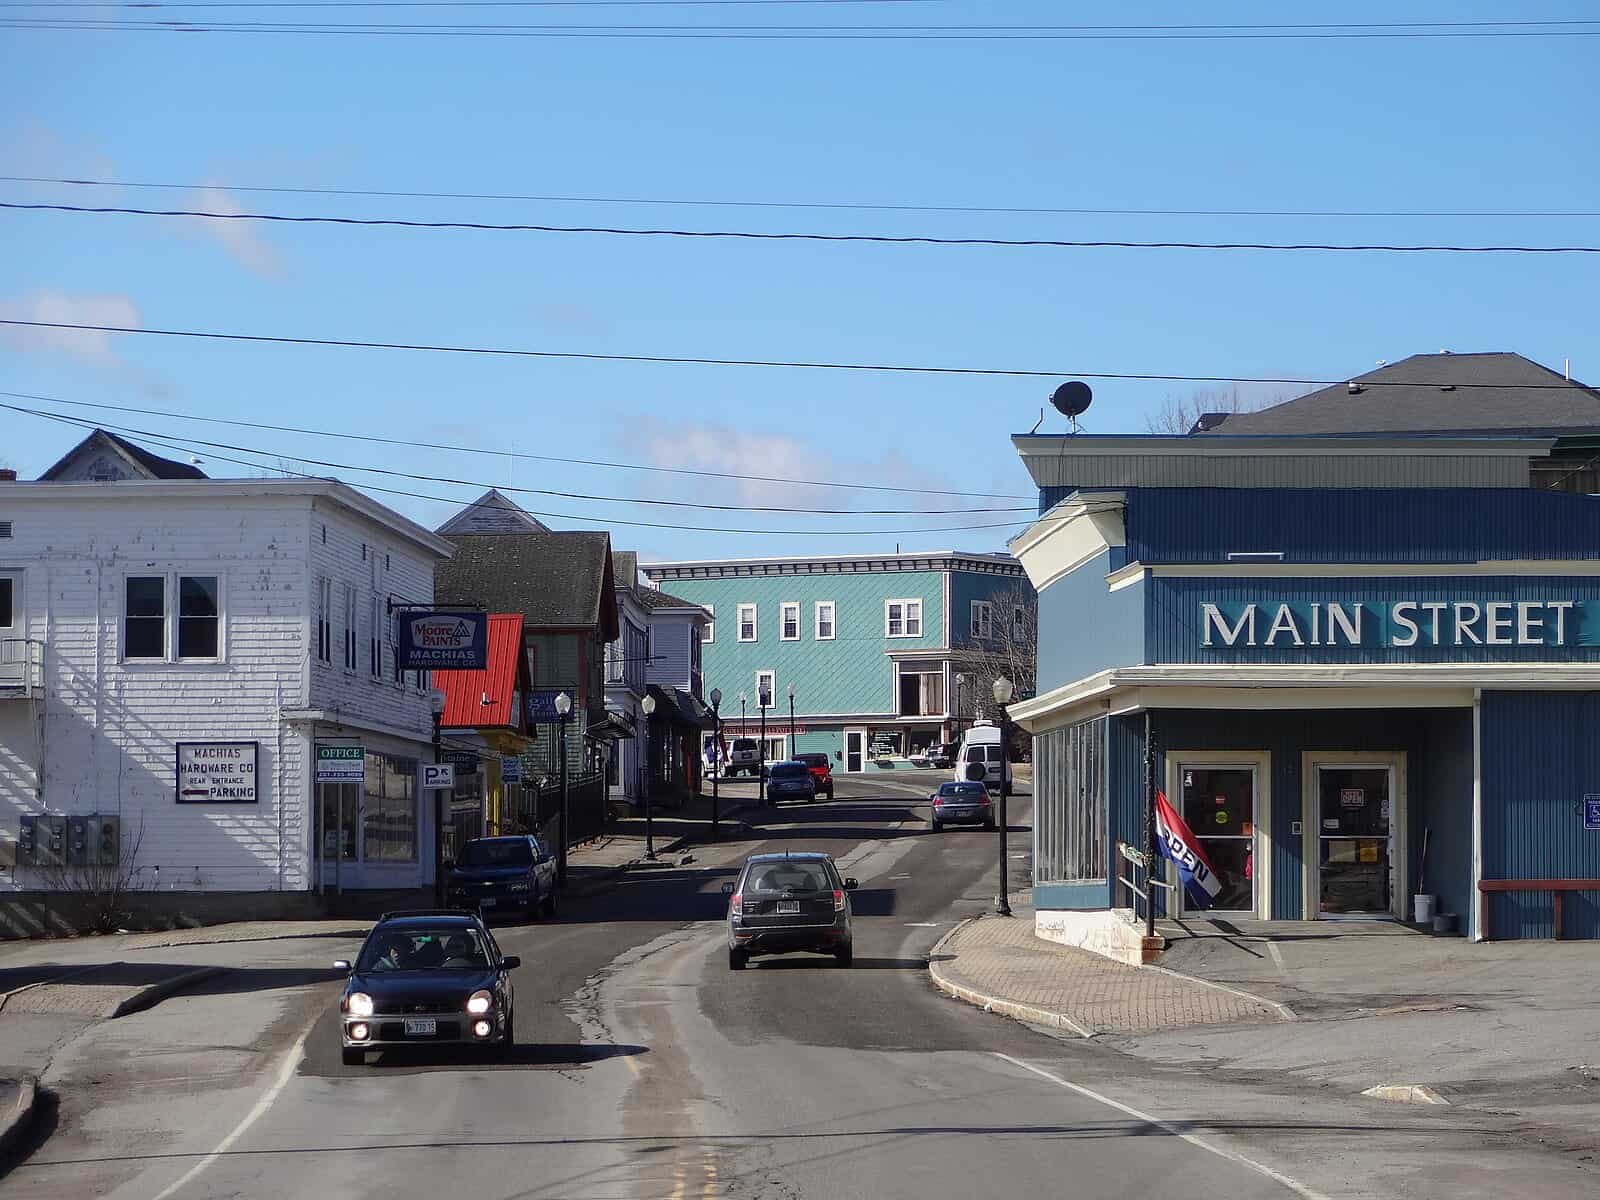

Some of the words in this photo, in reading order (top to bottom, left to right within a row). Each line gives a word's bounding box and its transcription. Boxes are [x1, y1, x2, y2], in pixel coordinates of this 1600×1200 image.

[415, 623, 453, 636] Moore
[1201, 602, 1363, 647] MAIN
[1391, 601, 1574, 647] STREET
[422, 635, 462, 647] PAINTS
[409, 650, 476, 660] MACHIAS
[194, 748, 241, 759] MACHIAS
[321, 748, 361, 758] OFFICE
[180, 763, 234, 774] HARDWARE
[189, 777, 207, 785] REAR
[211, 777, 245, 785] ENTRANCE
[210, 787, 254, 798] PARKING
